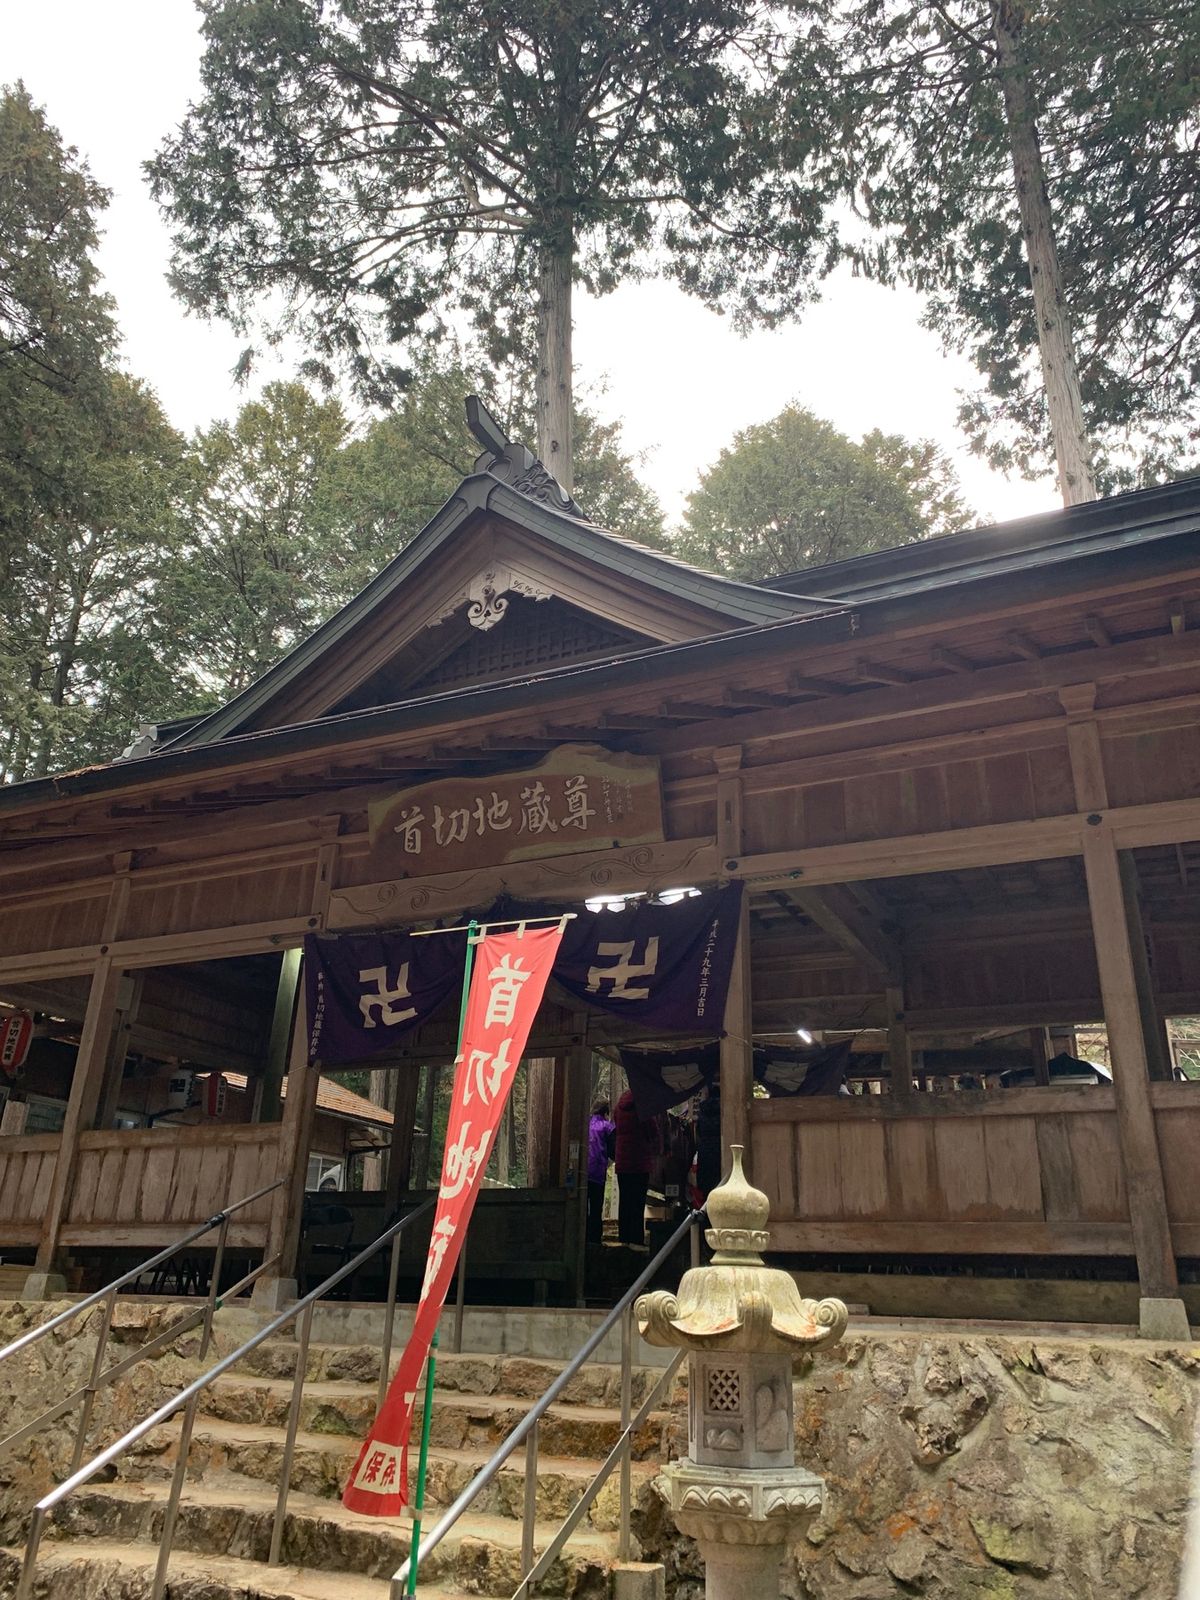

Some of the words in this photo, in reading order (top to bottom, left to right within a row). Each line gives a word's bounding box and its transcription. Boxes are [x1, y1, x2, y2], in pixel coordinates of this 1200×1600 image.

[394, 775, 596, 855] 首切地蔵尊
[697, 919, 719, 1017] 平成二十九年三月吉日
